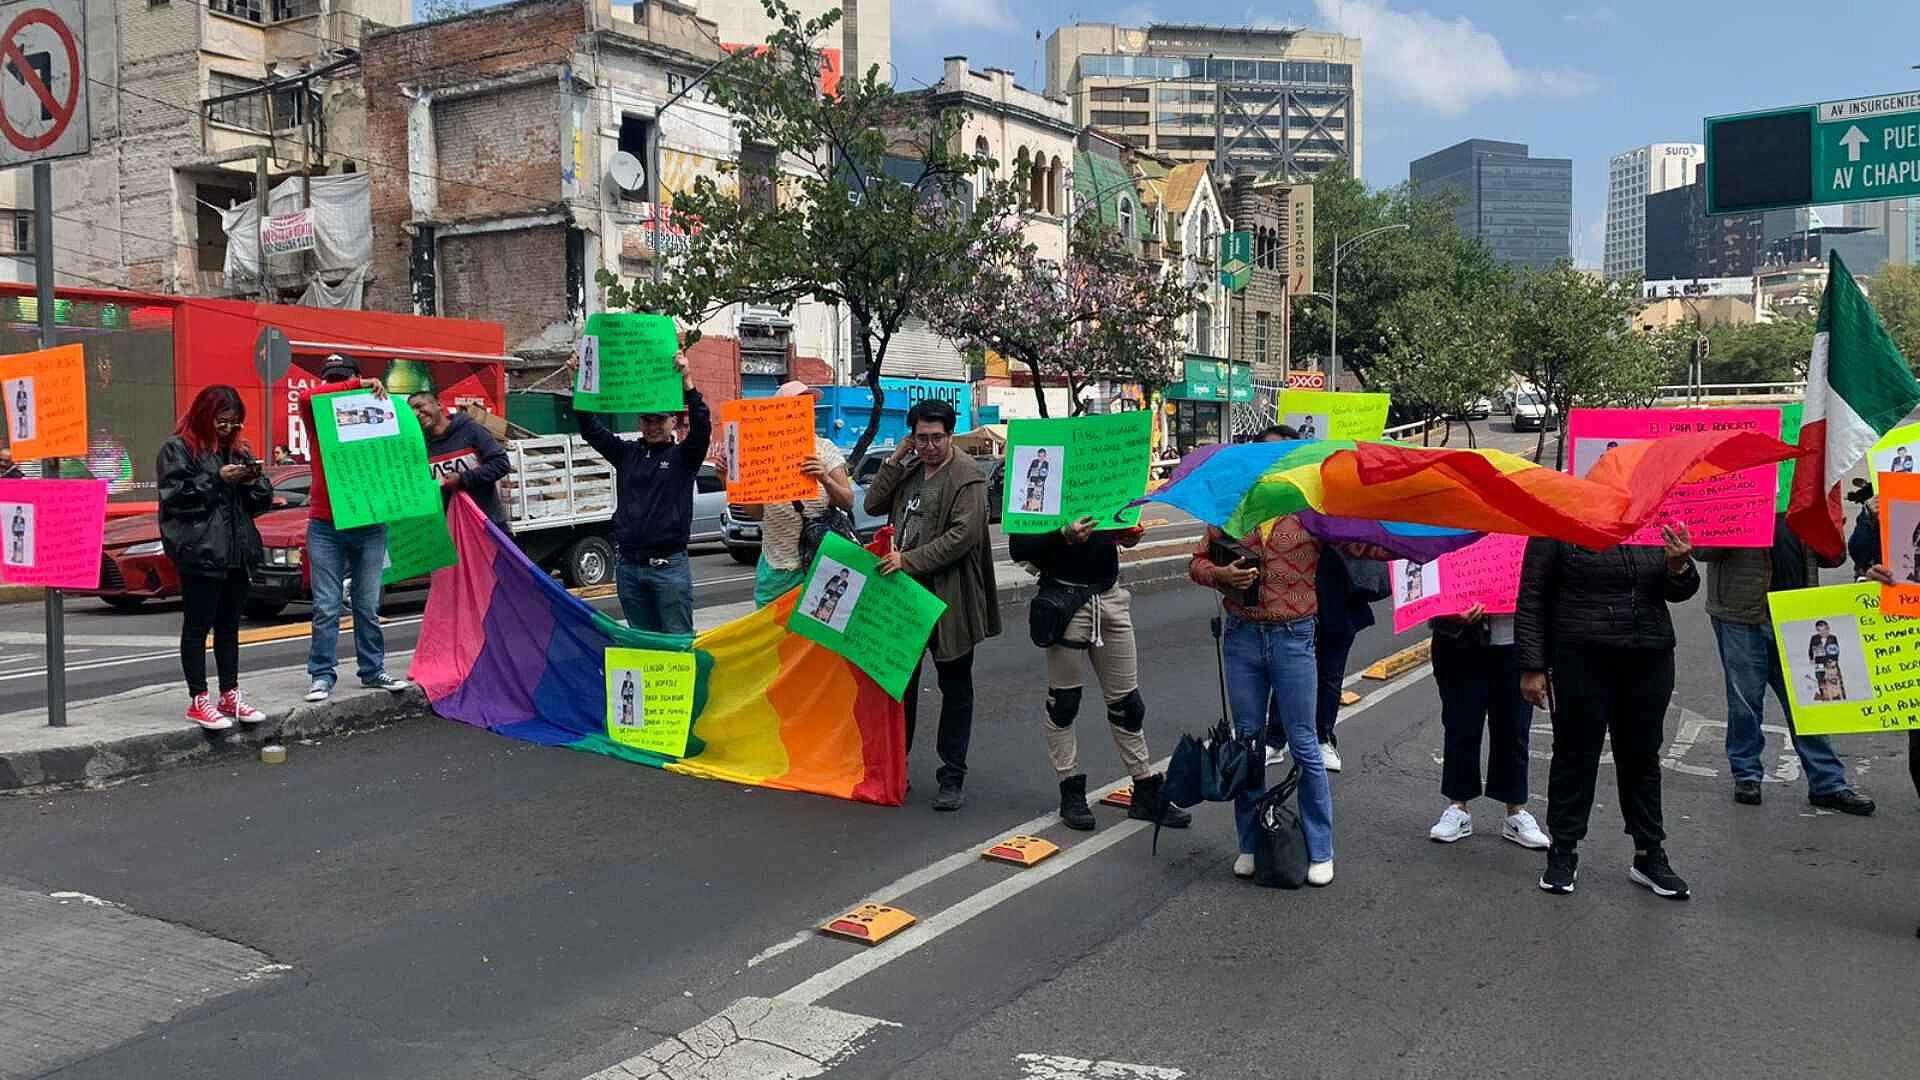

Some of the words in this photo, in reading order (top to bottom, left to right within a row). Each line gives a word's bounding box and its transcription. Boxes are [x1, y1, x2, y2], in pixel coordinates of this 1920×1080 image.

[1831, 105, 1843, 117] AV
[1884, 124, 1920, 150] PUE
[1833, 167, 1853, 189] AV
[1288, 375, 1323, 389] OXXO
